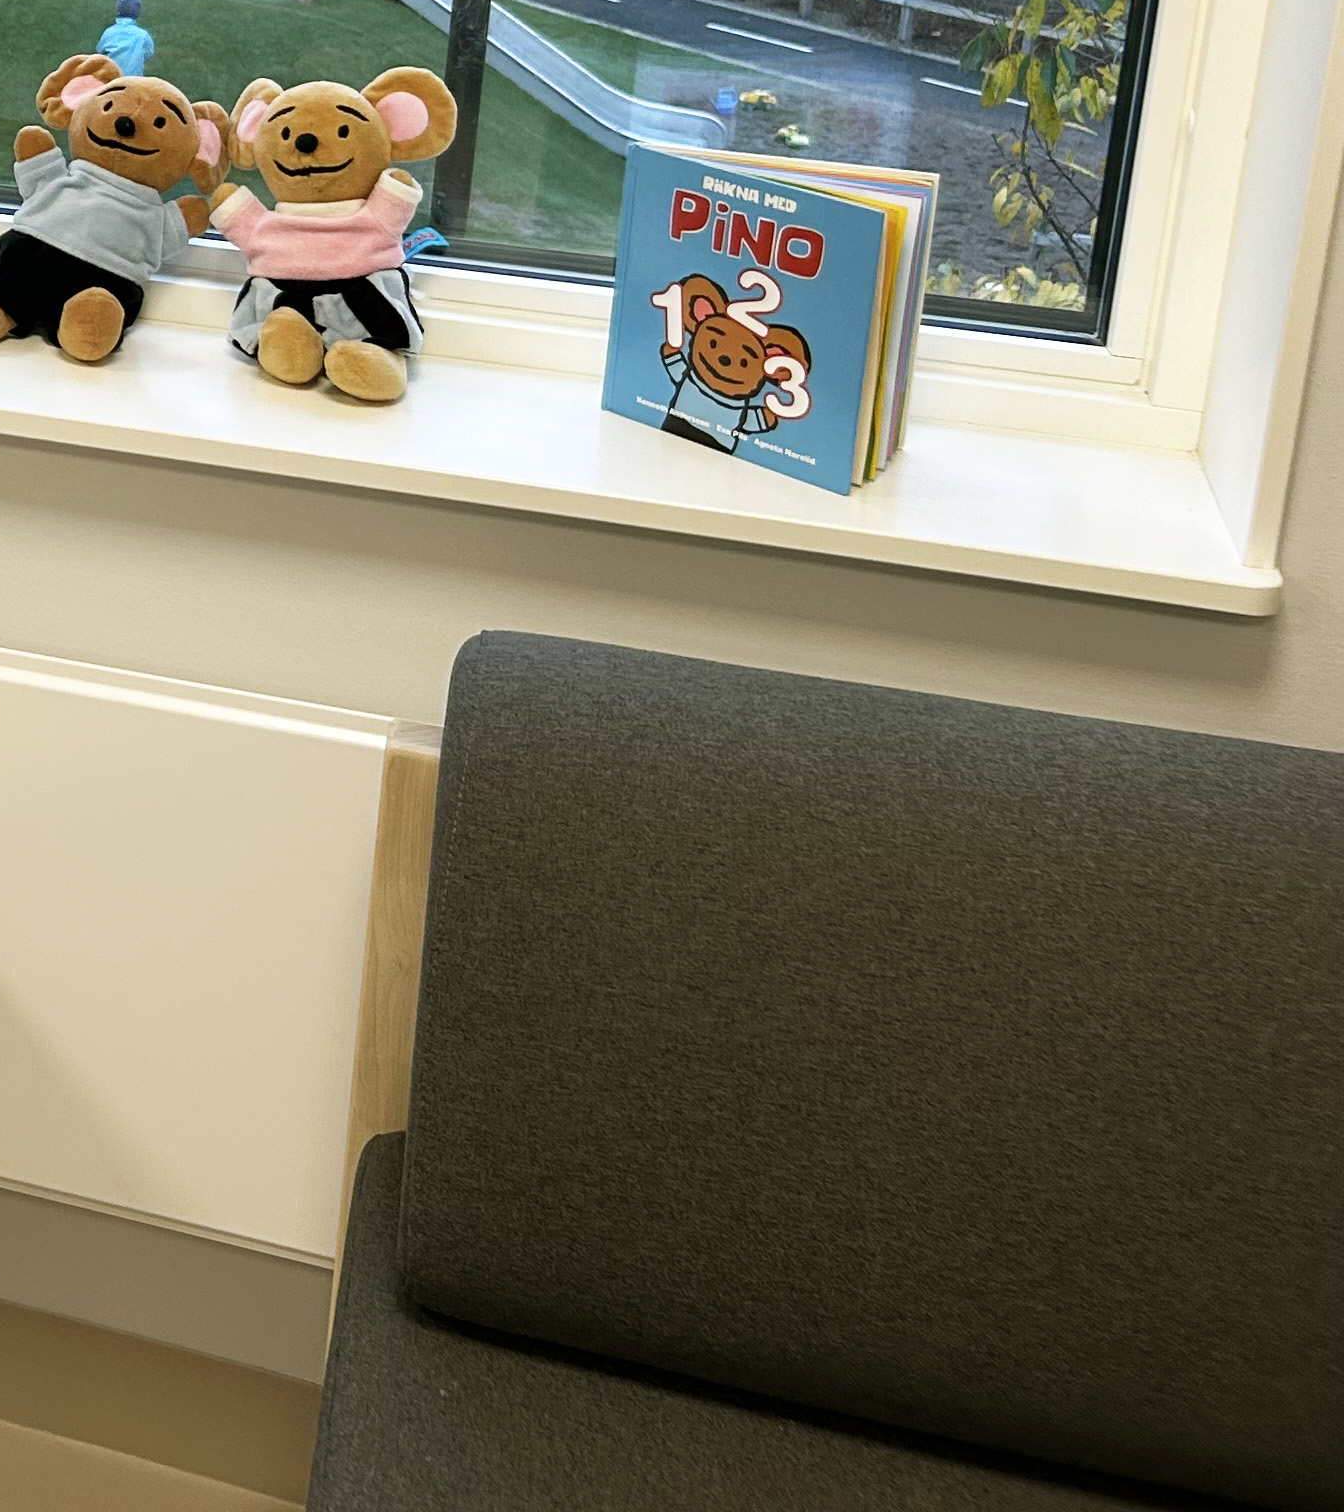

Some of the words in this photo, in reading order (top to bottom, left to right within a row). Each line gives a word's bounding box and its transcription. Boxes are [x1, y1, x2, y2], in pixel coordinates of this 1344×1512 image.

[702, 176, 760, 203] RÄKNA
[764, 191, 797, 214] MED
[650, 283, 683, 348] 1
[726, 268, 782, 338] 2
[763, 354, 812, 420] 3
